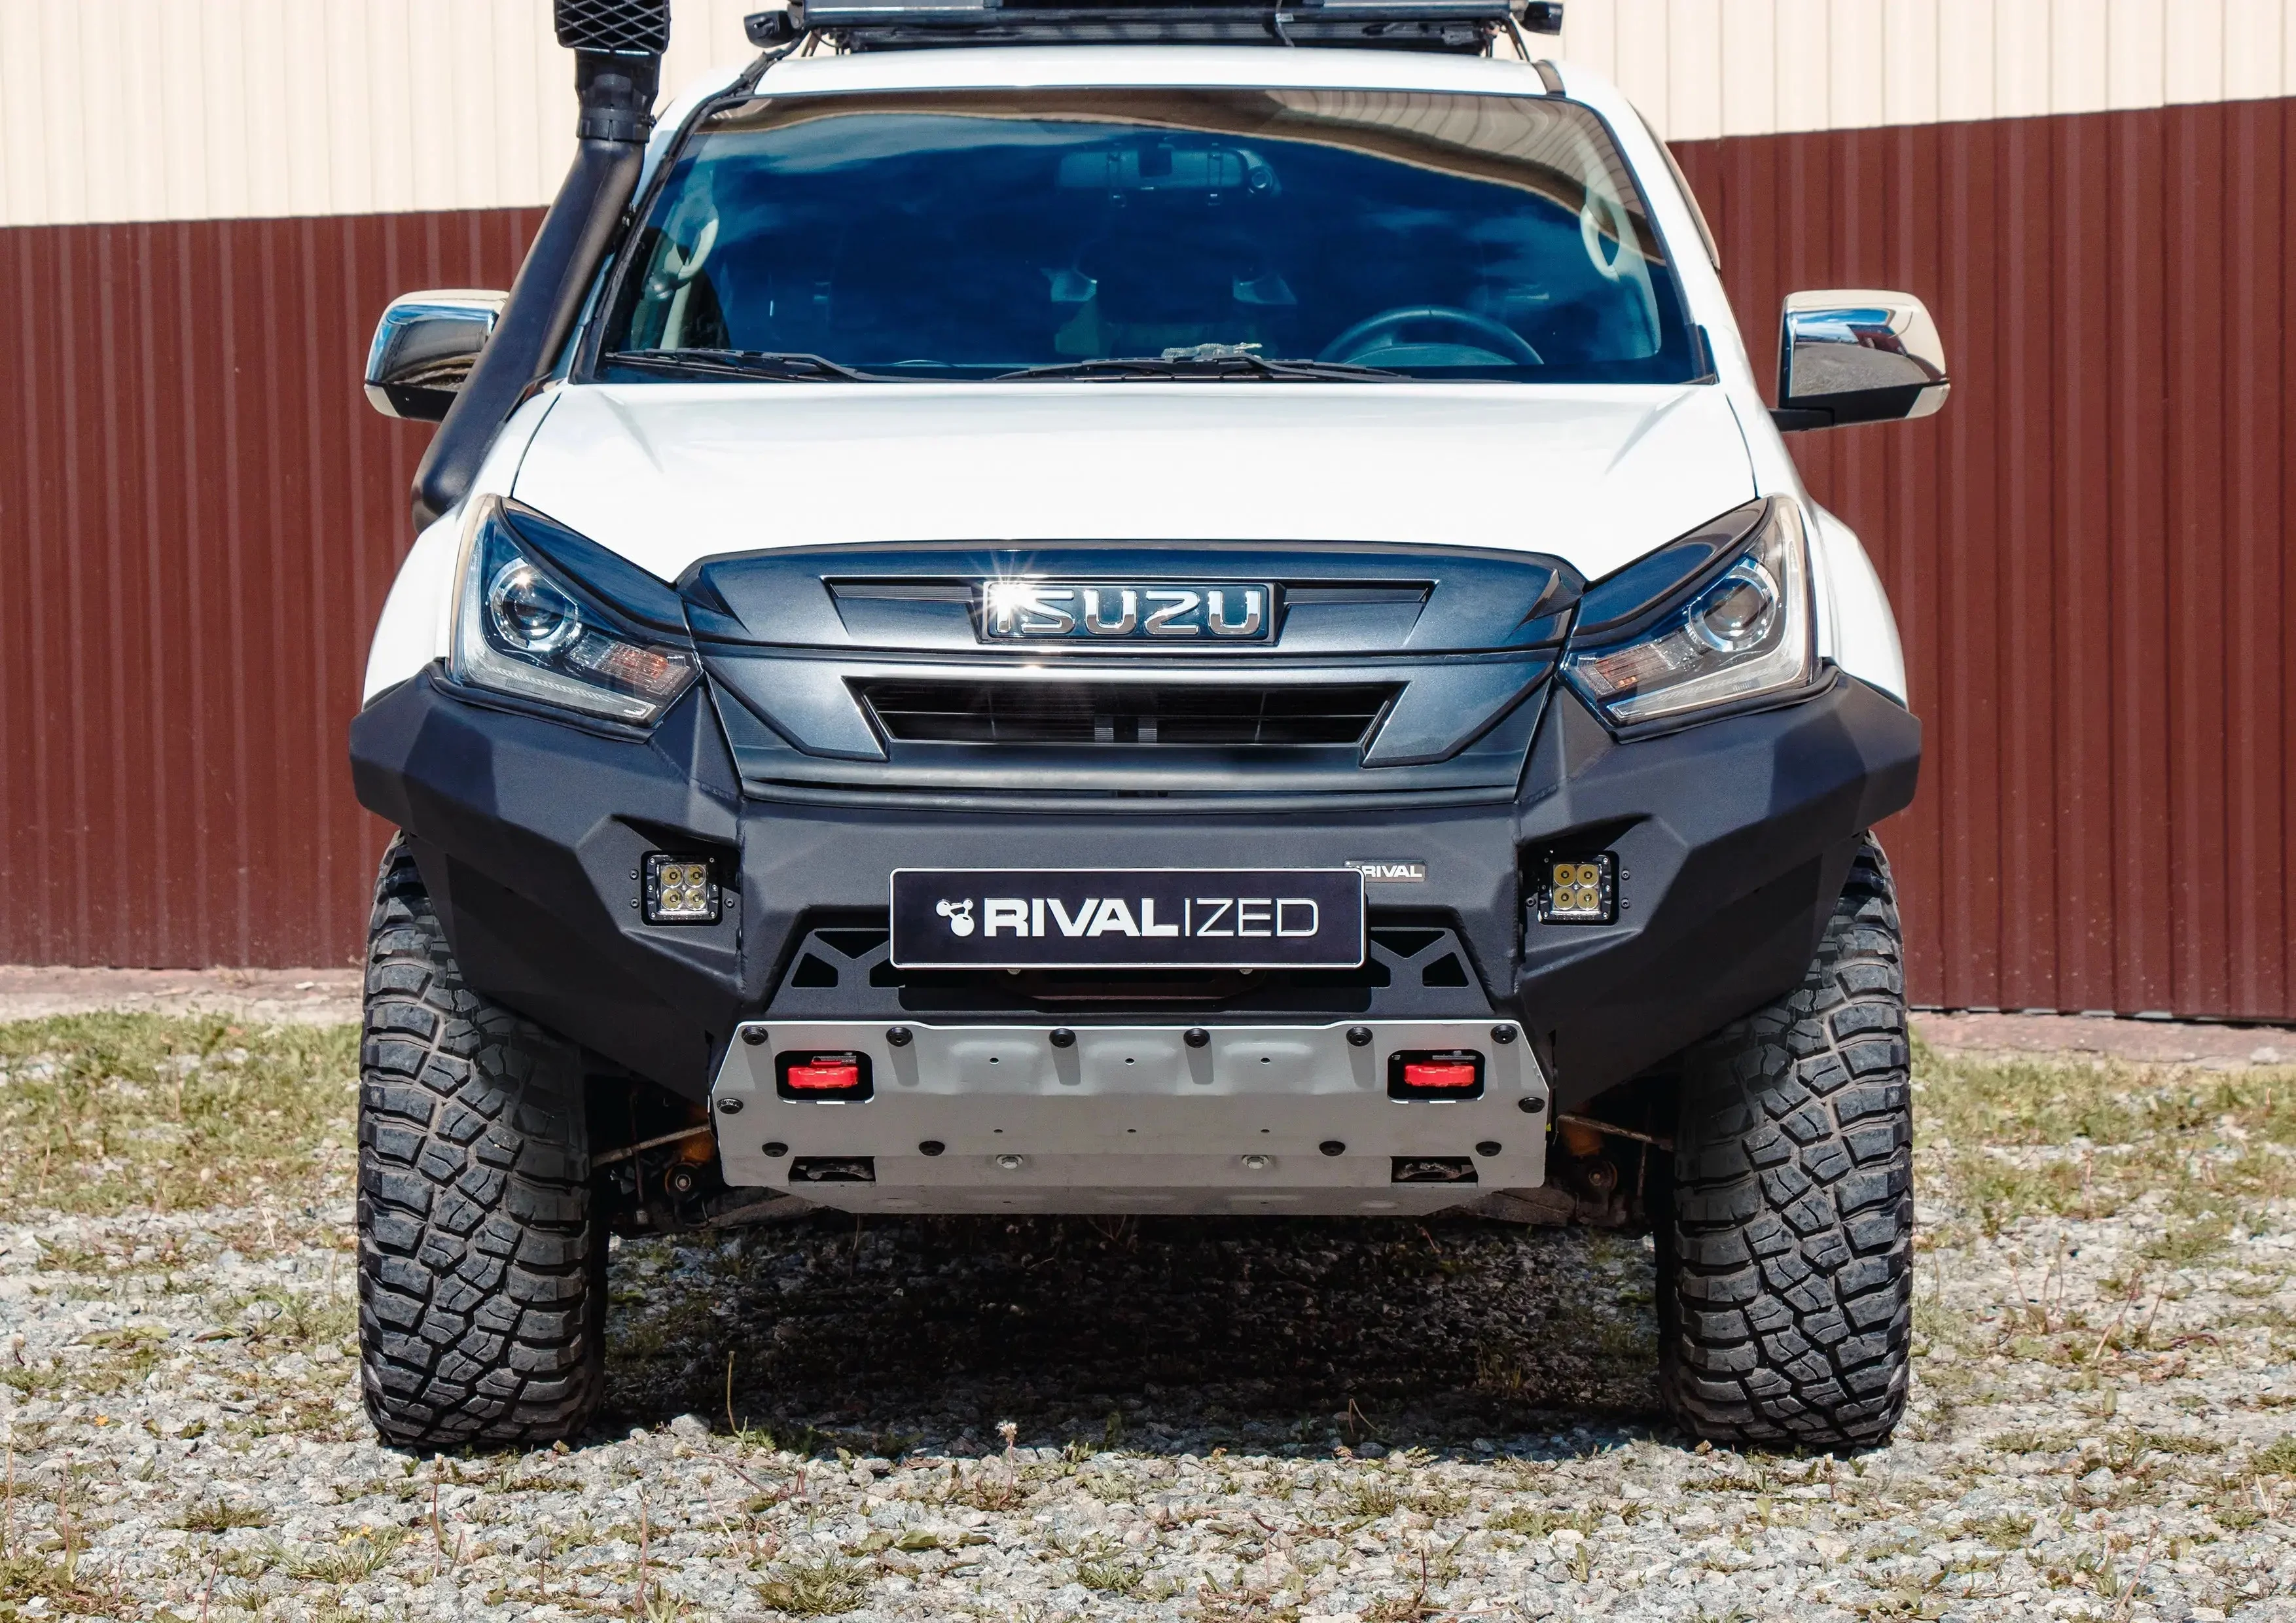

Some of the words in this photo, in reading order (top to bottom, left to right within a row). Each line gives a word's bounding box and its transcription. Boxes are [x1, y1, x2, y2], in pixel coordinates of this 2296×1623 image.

[995, 588, 1261, 635] ISUZU
[1361, 865, 1423, 878] RIVAL
[983, 897, 1319, 937] RIVALIZED
